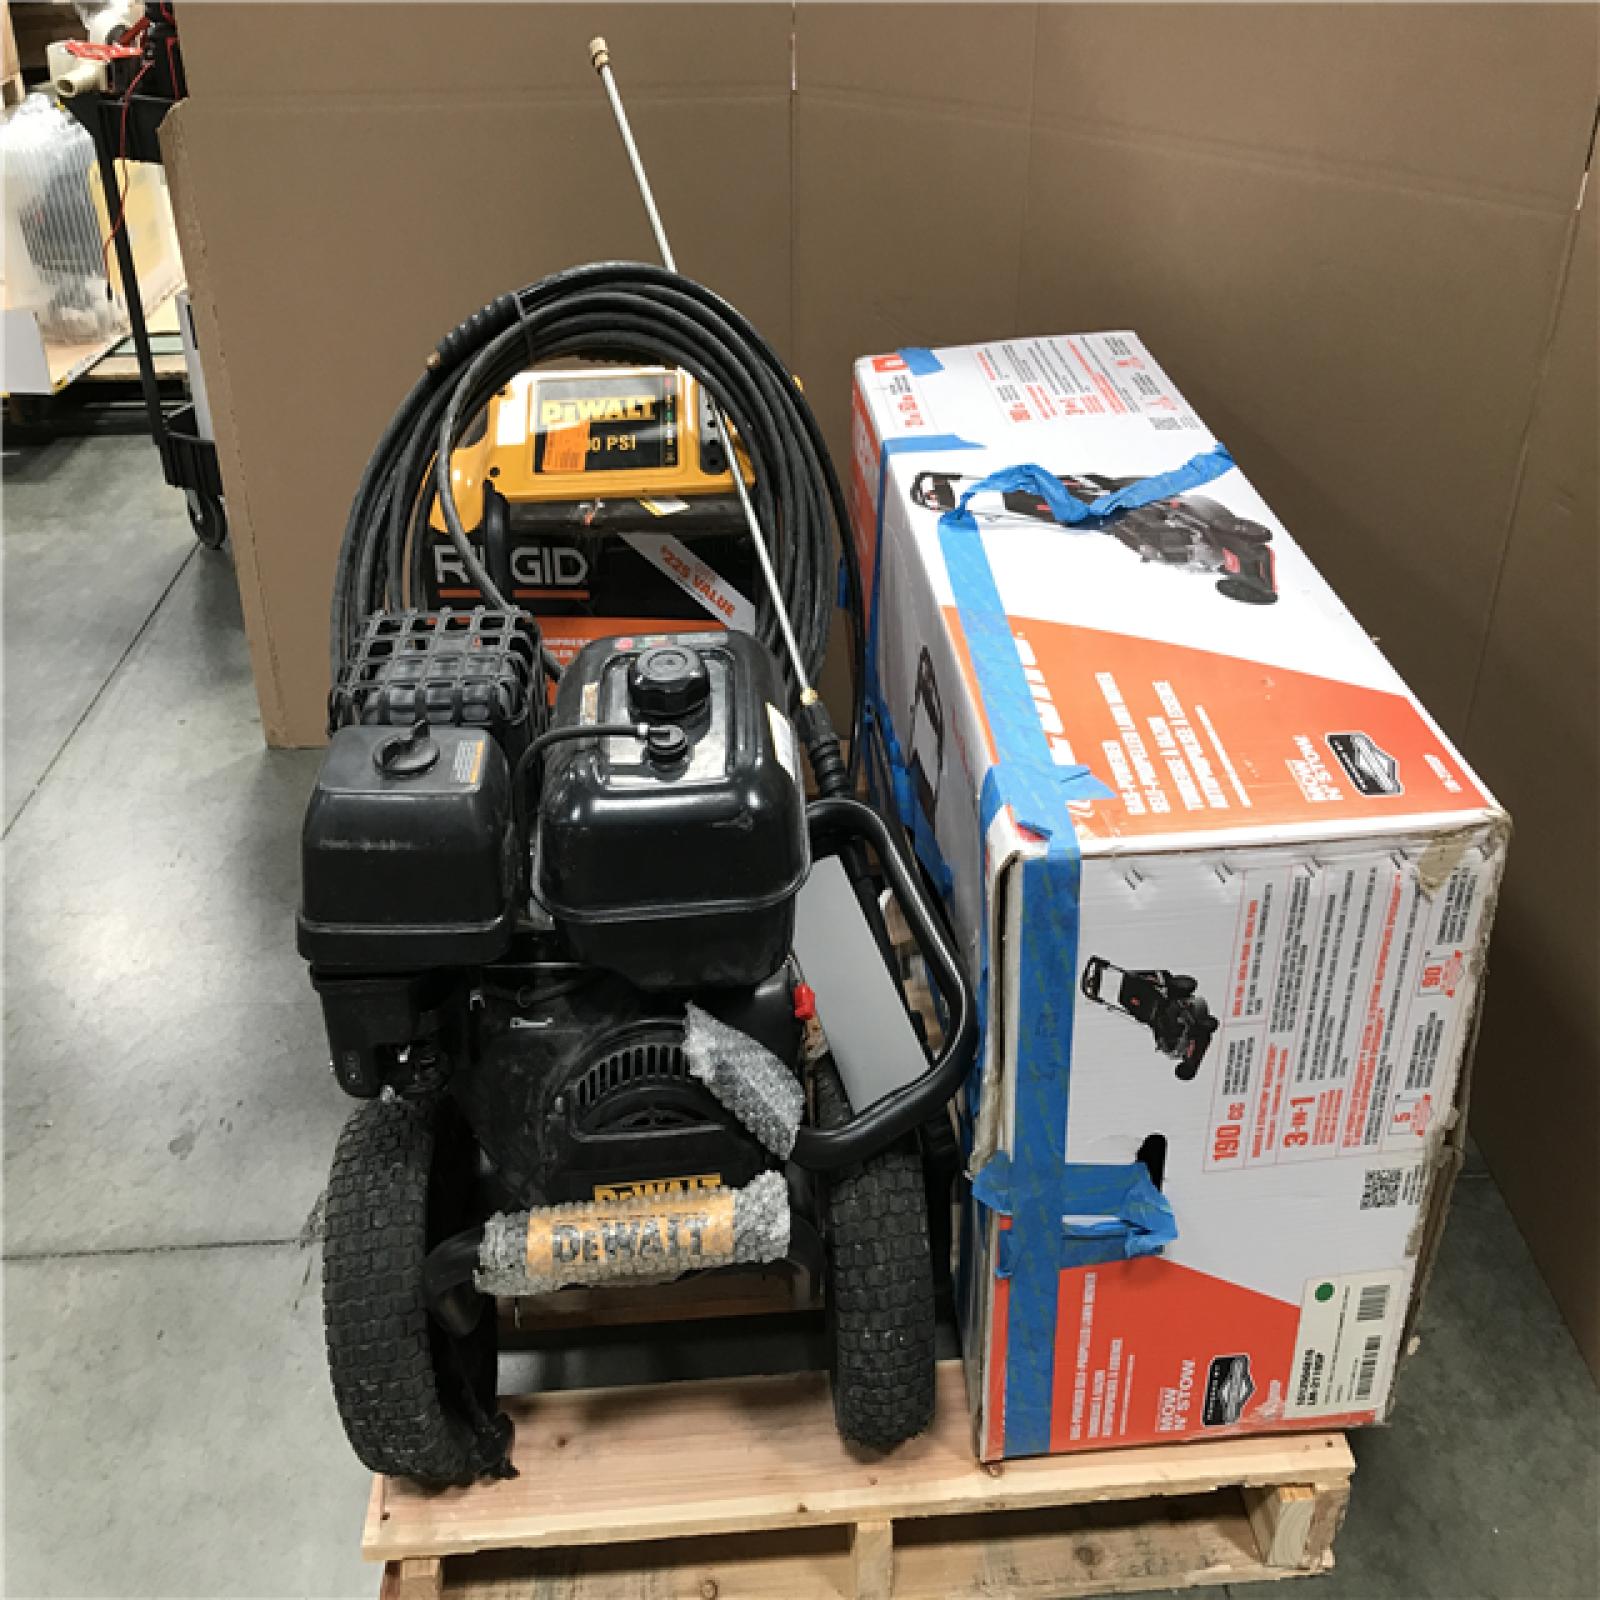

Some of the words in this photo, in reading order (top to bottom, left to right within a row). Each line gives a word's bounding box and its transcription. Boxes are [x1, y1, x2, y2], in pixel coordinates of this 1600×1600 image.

[607, 434, 636, 451] PSI
[434, 545, 588, 584] RGID
[692, 575, 736, 619] VALUE
[1212, 1124, 1241, 1162] 190
[551, 1213, 712, 1263] DEWALT
[1177, 1359, 1195, 1410] STOW
[1158, 1387, 1177, 1432] MOW
